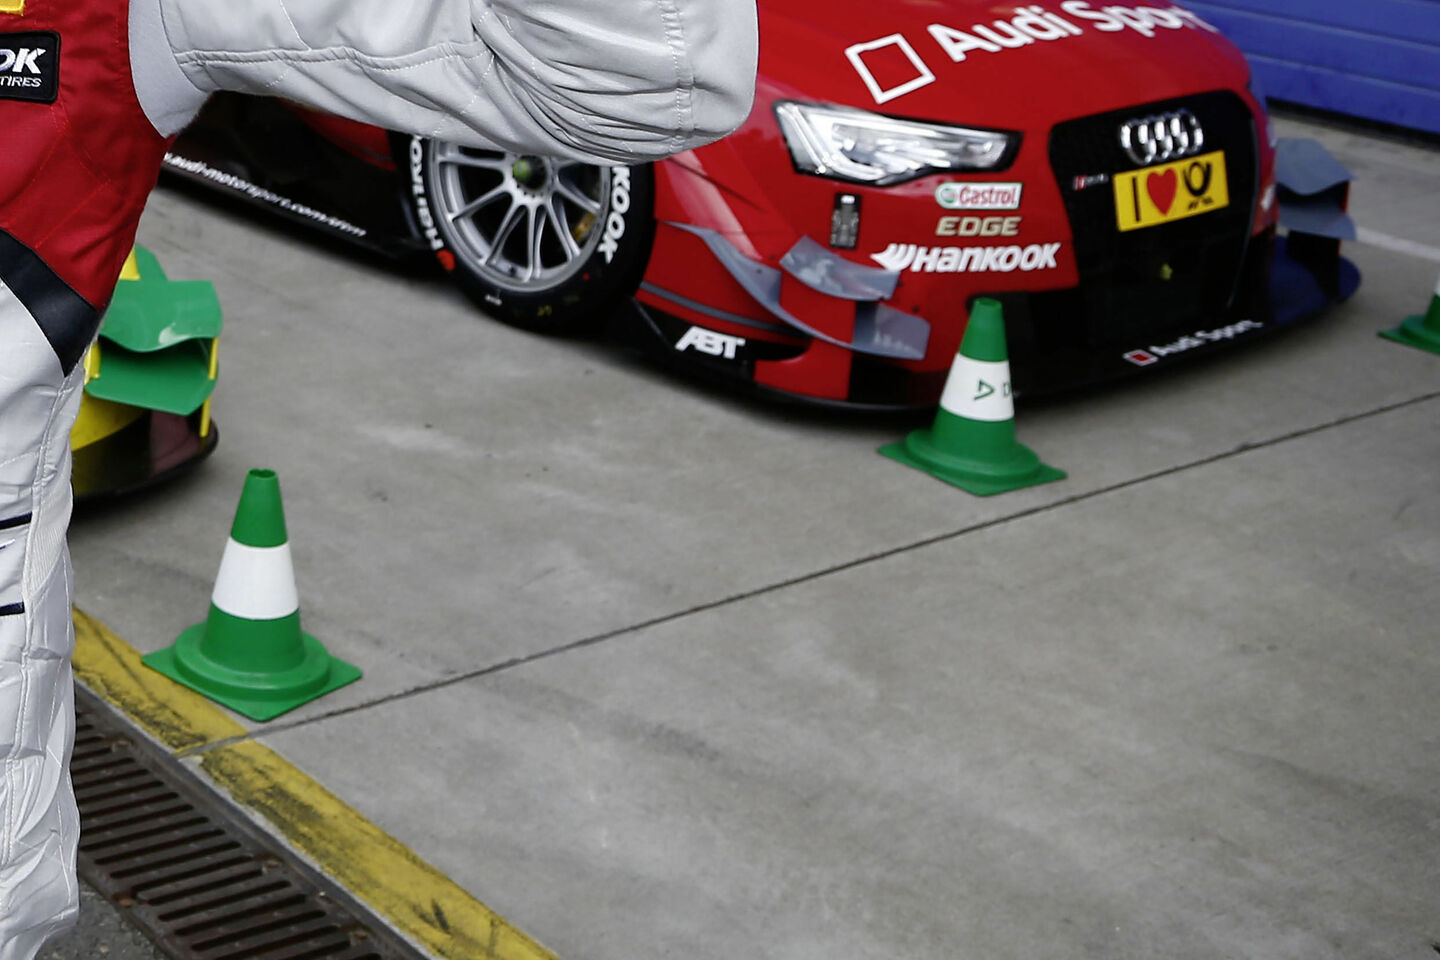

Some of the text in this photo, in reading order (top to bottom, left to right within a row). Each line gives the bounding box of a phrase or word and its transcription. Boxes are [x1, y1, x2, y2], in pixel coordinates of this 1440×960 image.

[927, 4, 1084, 63] Audi
[960, 186, 1017, 206] Castrol
[936, 215, 1022, 237] EDGE
[674, 325, 747, 360] ABT
